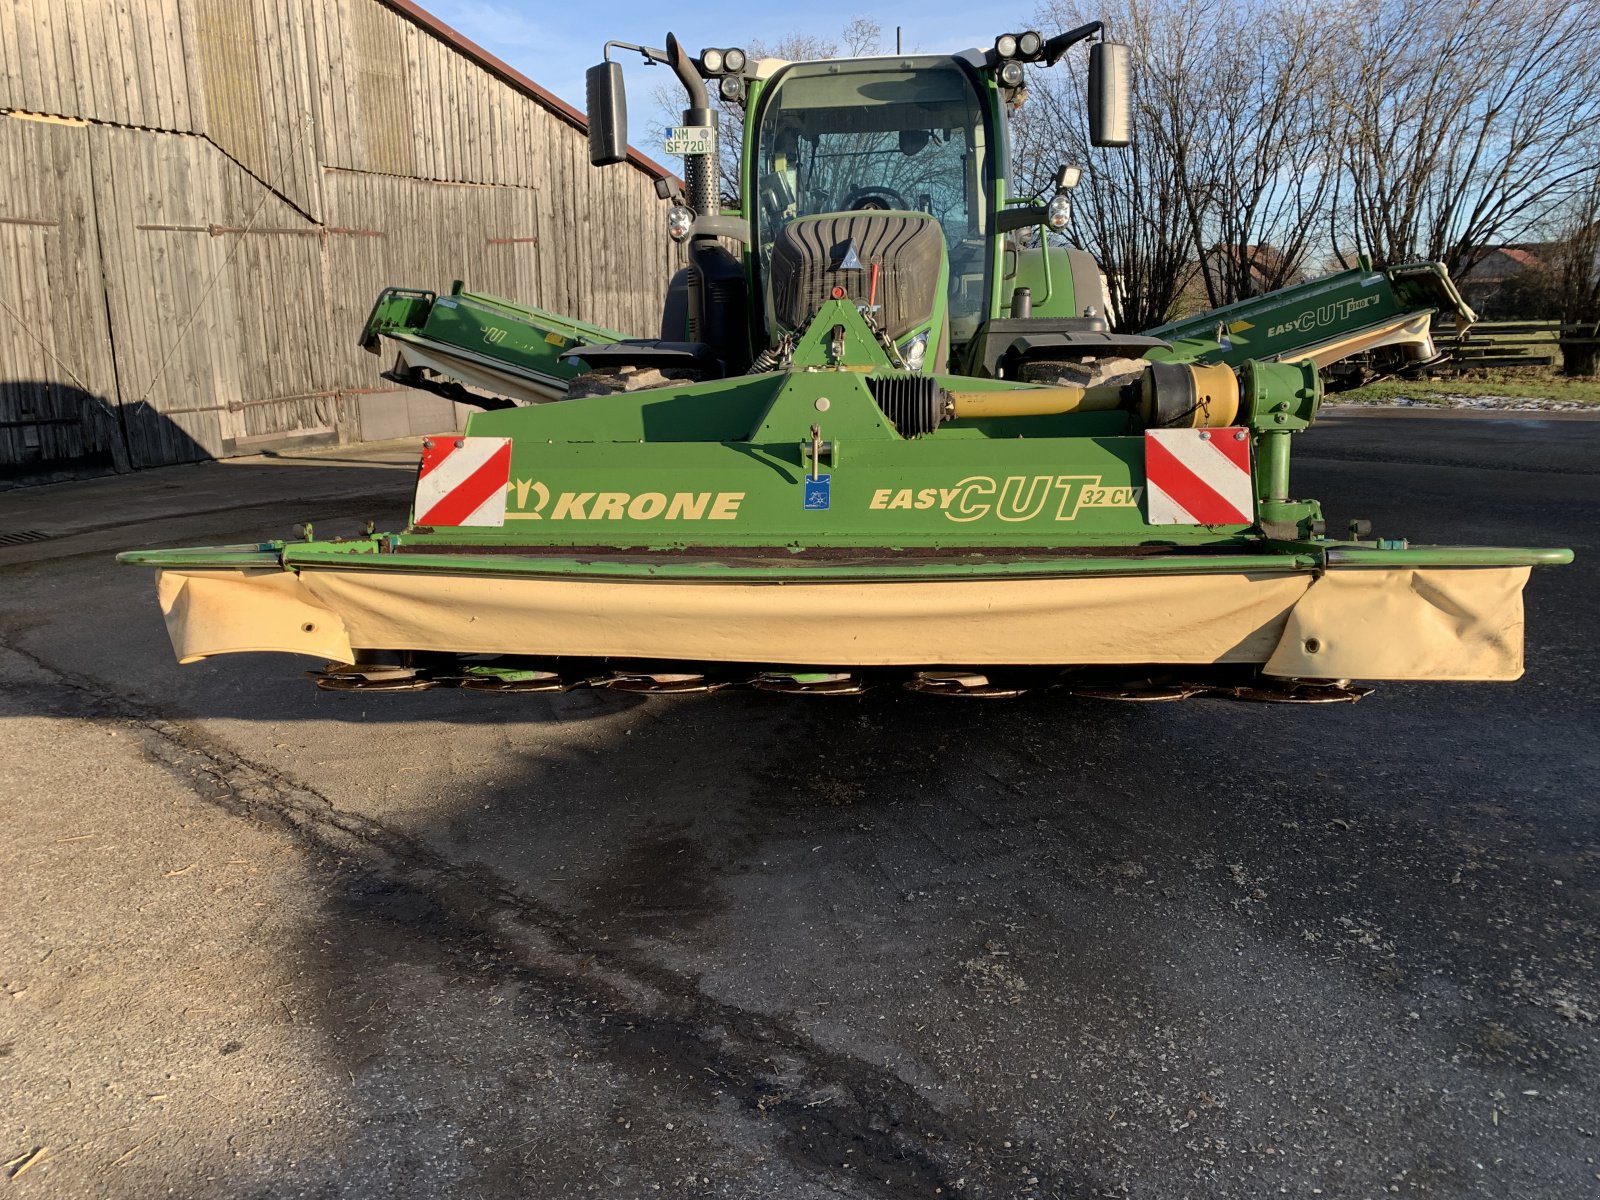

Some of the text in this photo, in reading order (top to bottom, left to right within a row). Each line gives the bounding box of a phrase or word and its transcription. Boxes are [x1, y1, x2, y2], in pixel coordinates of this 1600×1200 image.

[674, 129, 689, 140] NM
[1082, 489, 1106, 505] 32
[1110, 489, 1139, 505] CV
[550, 492, 746, 520] KRONE
